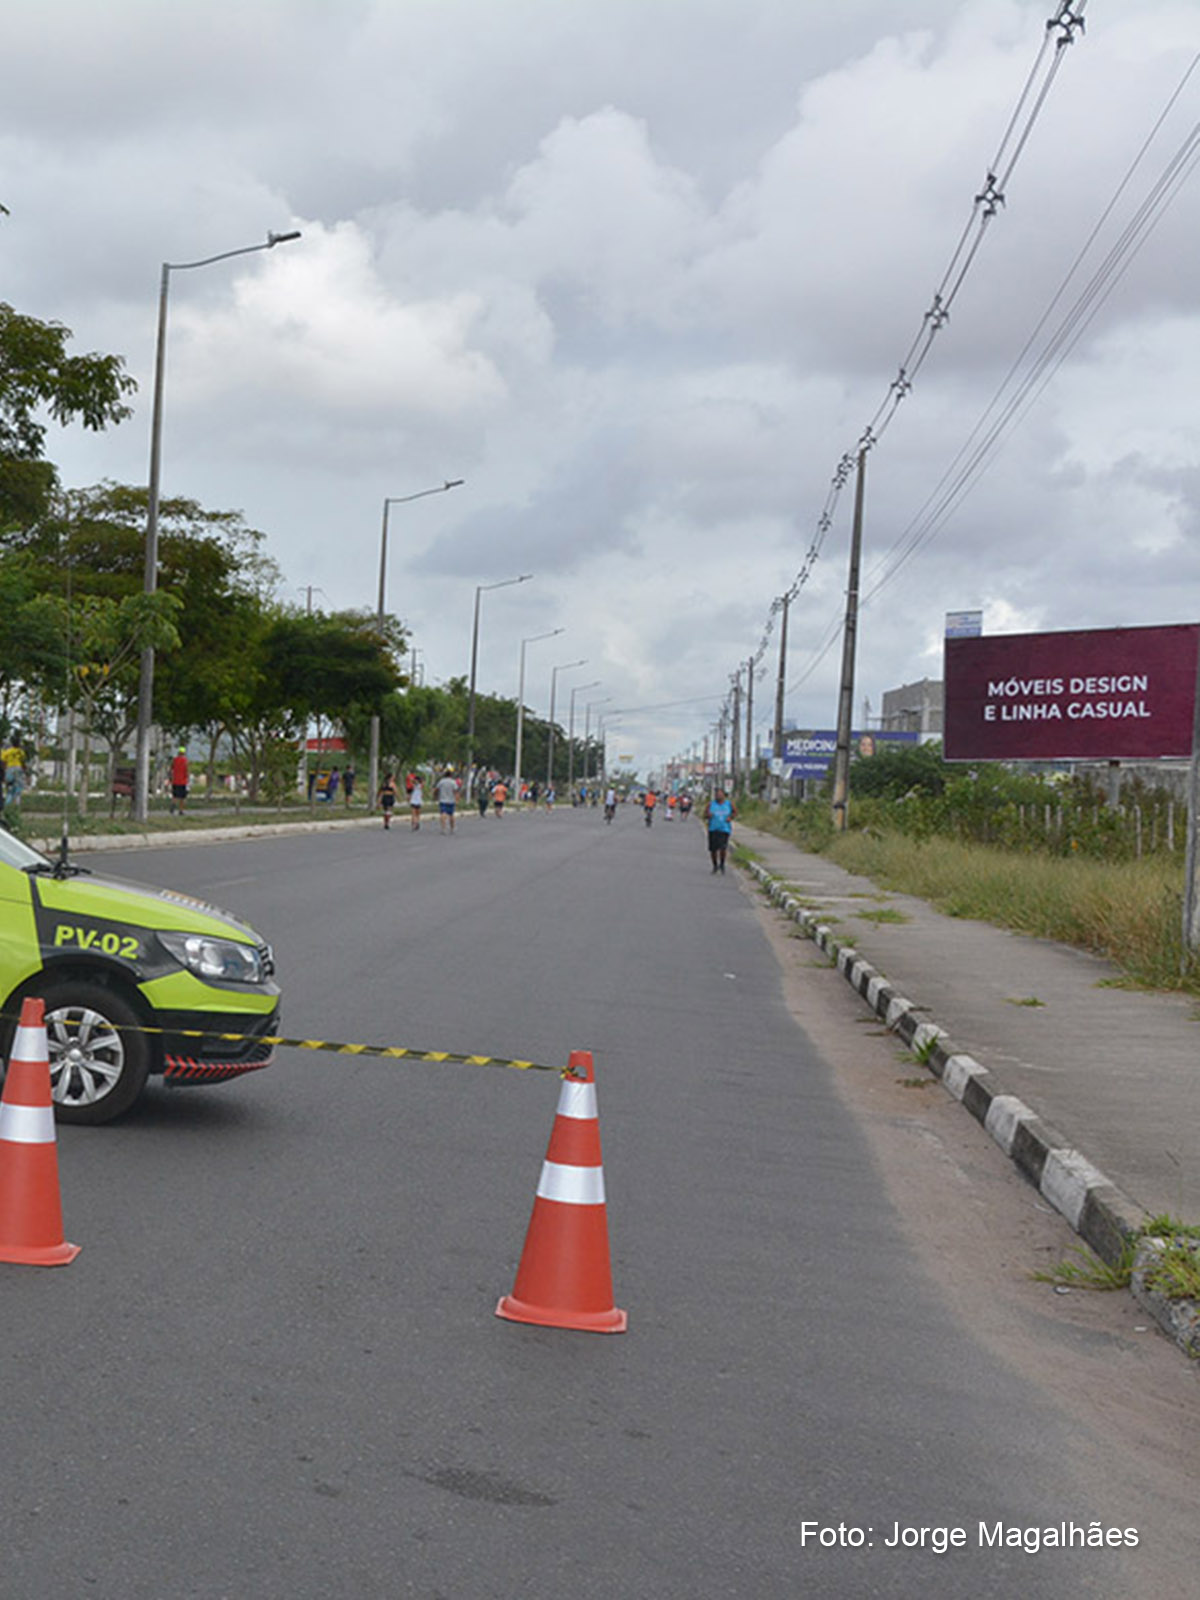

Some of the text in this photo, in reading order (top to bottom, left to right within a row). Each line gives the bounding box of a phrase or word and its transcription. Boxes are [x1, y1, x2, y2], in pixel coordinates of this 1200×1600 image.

[987, 675, 1148, 697] MÓVEIS DESIGN
[984, 701, 1151, 721] E LINHA CASUAL
[54, 925, 140, 959] PV-02
